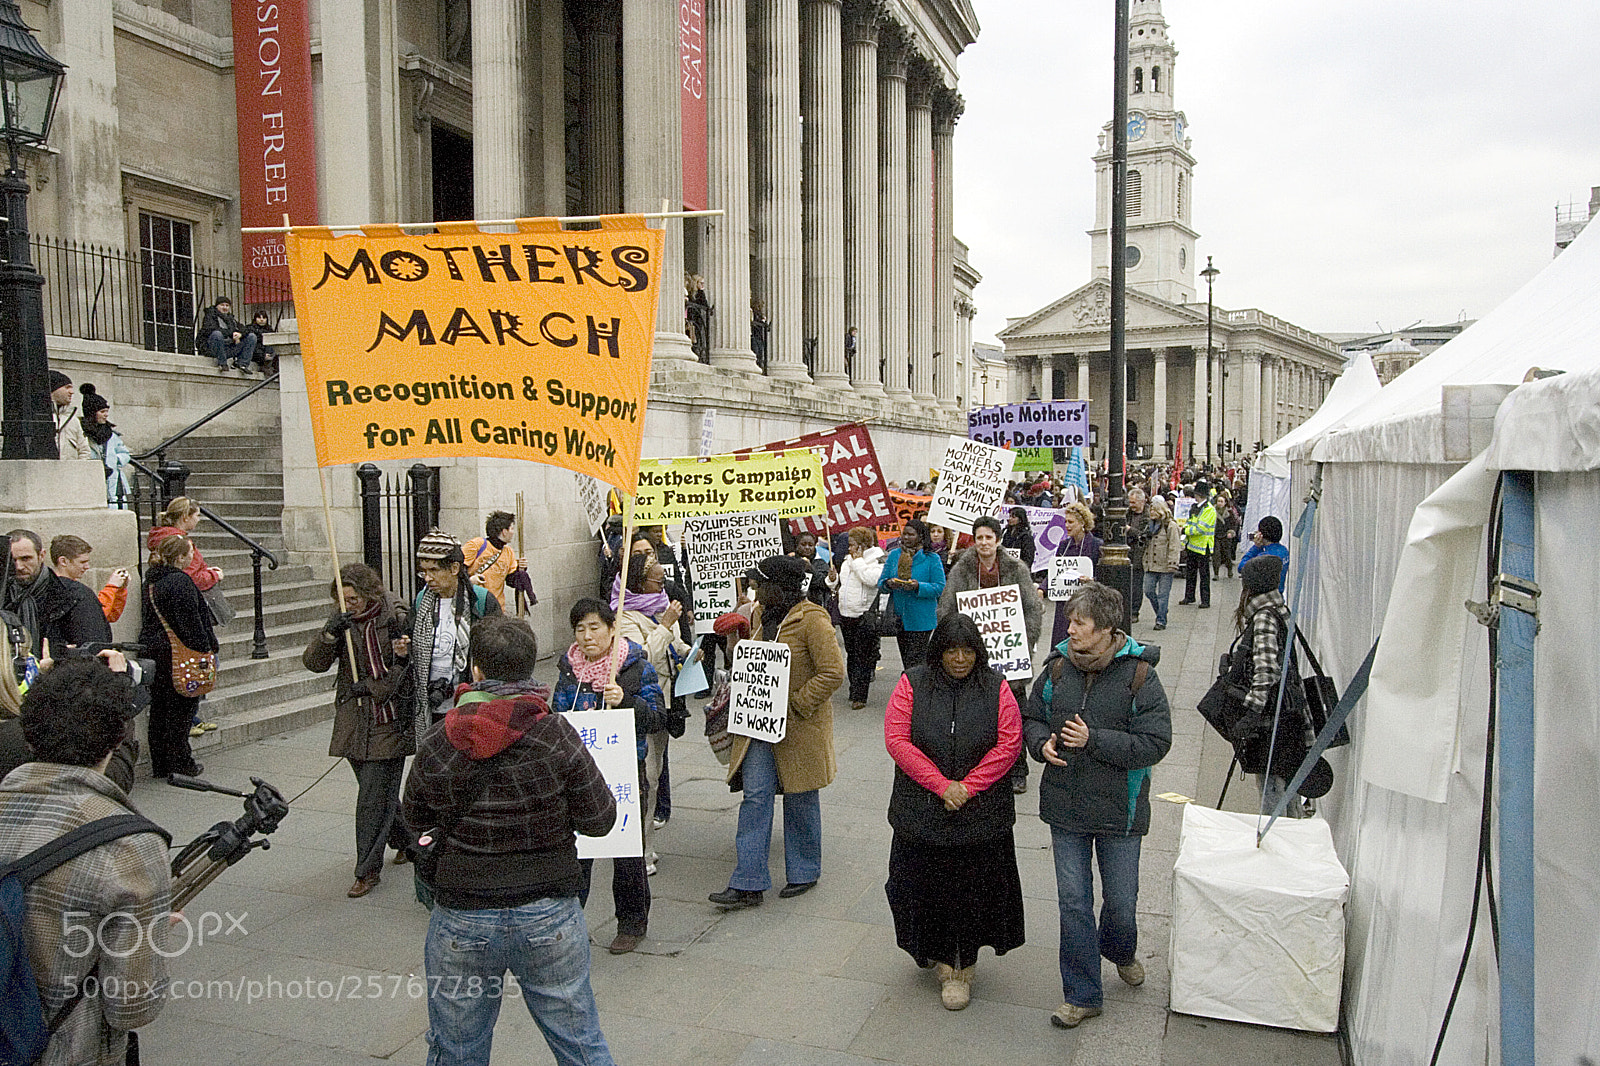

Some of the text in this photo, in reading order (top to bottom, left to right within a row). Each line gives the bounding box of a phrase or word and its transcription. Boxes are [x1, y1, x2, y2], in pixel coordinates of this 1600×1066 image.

[262, 110, 287, 205] FREE
[313, 244, 649, 292] MOTHERS
[366, 307, 620, 358] MARCH
[326, 374, 637, 424] Recognition & Support
[969, 404, 1086, 428] Single Mothers'
[363, 418, 617, 469] for All Caring Work
[962, 442, 997, 459] MOST
[944, 459, 971, 473] EARN
[638, 466, 811, 487] Mothers Campaign
[824, 464, 877, 497] EN'S
[942, 469, 961, 483] TRY
[964, 475, 1002, 497] RAISING
[663, 488, 729, 508] Family
[739, 486, 817, 505] Reunion
[938, 497, 955, 507] ON
[942, 482, 999, 506] A FAMILY
[658, 510, 711, 519] AFRICAN
[779, 505, 815, 515] ROUP
[692, 527, 766, 543] MOTHERS ON
[687, 541, 733, 555] HUNGER
[690, 548, 780, 565] AGAINST DETENTION
[1056, 559, 1079, 567] CADA
[693, 580, 731, 591] MOTHERS
[958, 589, 1018, 611] MOTHERS
[1002, 606, 1017, 617] TO
[1004, 633, 1022, 648] 6%
[737, 645, 790, 668] DEFENDING
[746, 662, 767, 674] OUR
[732, 671, 780, 688] CHILDREN
[747, 685, 770, 699] FROM
[736, 693, 773, 713] RACISM
[733, 711, 785, 738] IS WORK!
